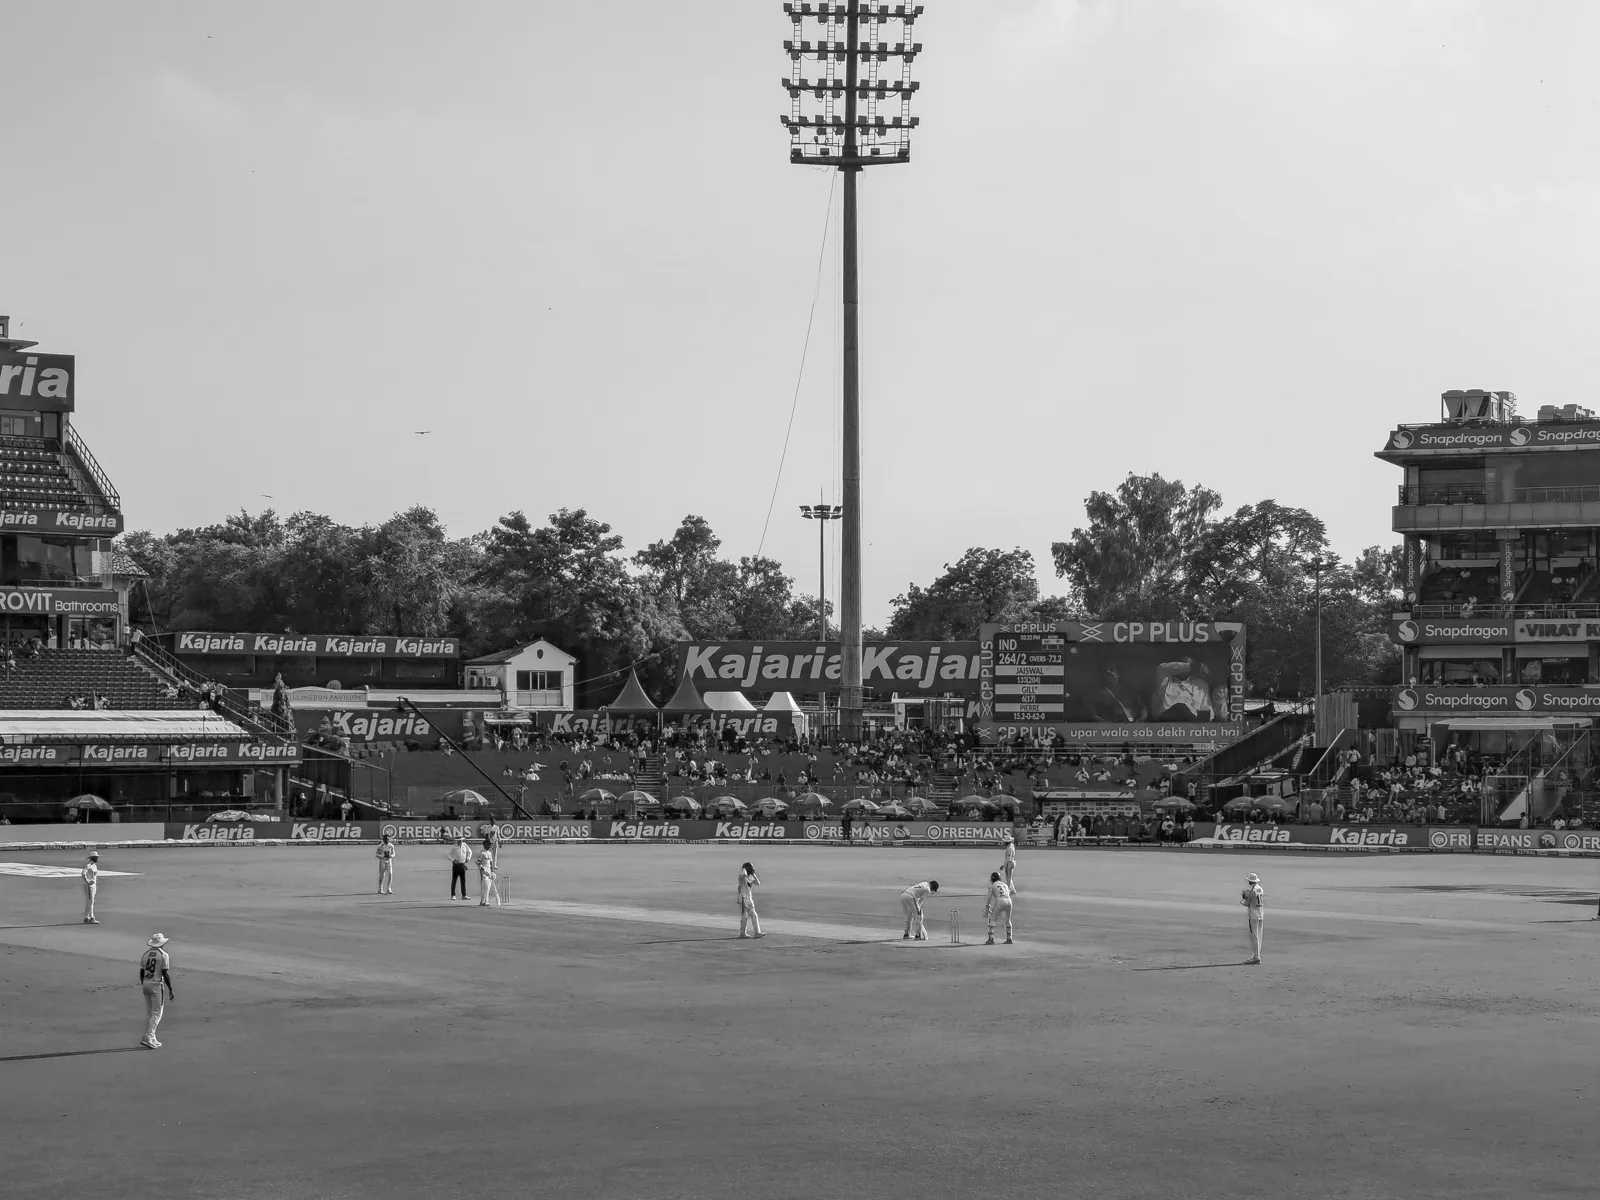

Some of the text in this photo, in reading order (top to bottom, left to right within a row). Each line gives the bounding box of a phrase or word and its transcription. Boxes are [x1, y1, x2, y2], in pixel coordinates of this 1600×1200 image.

[1420, 434, 1502, 446] Snapdragon
[55, 512, 117, 530] Kajaria
[1406, 541, 1415, 588] Snapdragon
[55, 600, 118, 612] Bathrooms
[1014, 623, 1056, 633] CP PLUS
[1113, 622, 1209, 643] CP PLUS
[1425, 624, 1508, 639] Snapdragon
[1526, 623, 1580, 637] VIRAT
[180, 634, 454, 656] Kajaria Kajaria Kajaria Kajaria
[999, 639, 1017, 650] IND
[999, 653, 1027, 665] 264/2
[683, 646, 842, 688] Kajaria
[981, 641, 993, 700] CP PLUS
[1016, 667, 1044, 675] JAISWAL
[1231, 662, 1243, 722] CP PLUS
[1425, 693, 1508, 708] Snapdragon
[333, 712, 430, 740] Kajaria
[1020, 727, 1057, 740] PLUS
[1070, 727, 1239, 739] upar wala sab dekh raha hai
[84, 745, 147, 761] Kajaria
[170, 744, 228, 760] Kajaria
[238, 743, 297, 760] Kajaria
[183, 823, 362, 840] Kajaria Kajaria
[399, 825, 589, 838] FREEMANS FREEMANS
[610, 822, 785, 840] Kajaria Kajaria
[942, 827, 1011, 839] FREEMANS
[1214, 825, 1408, 846] Kajaria Kajaria
